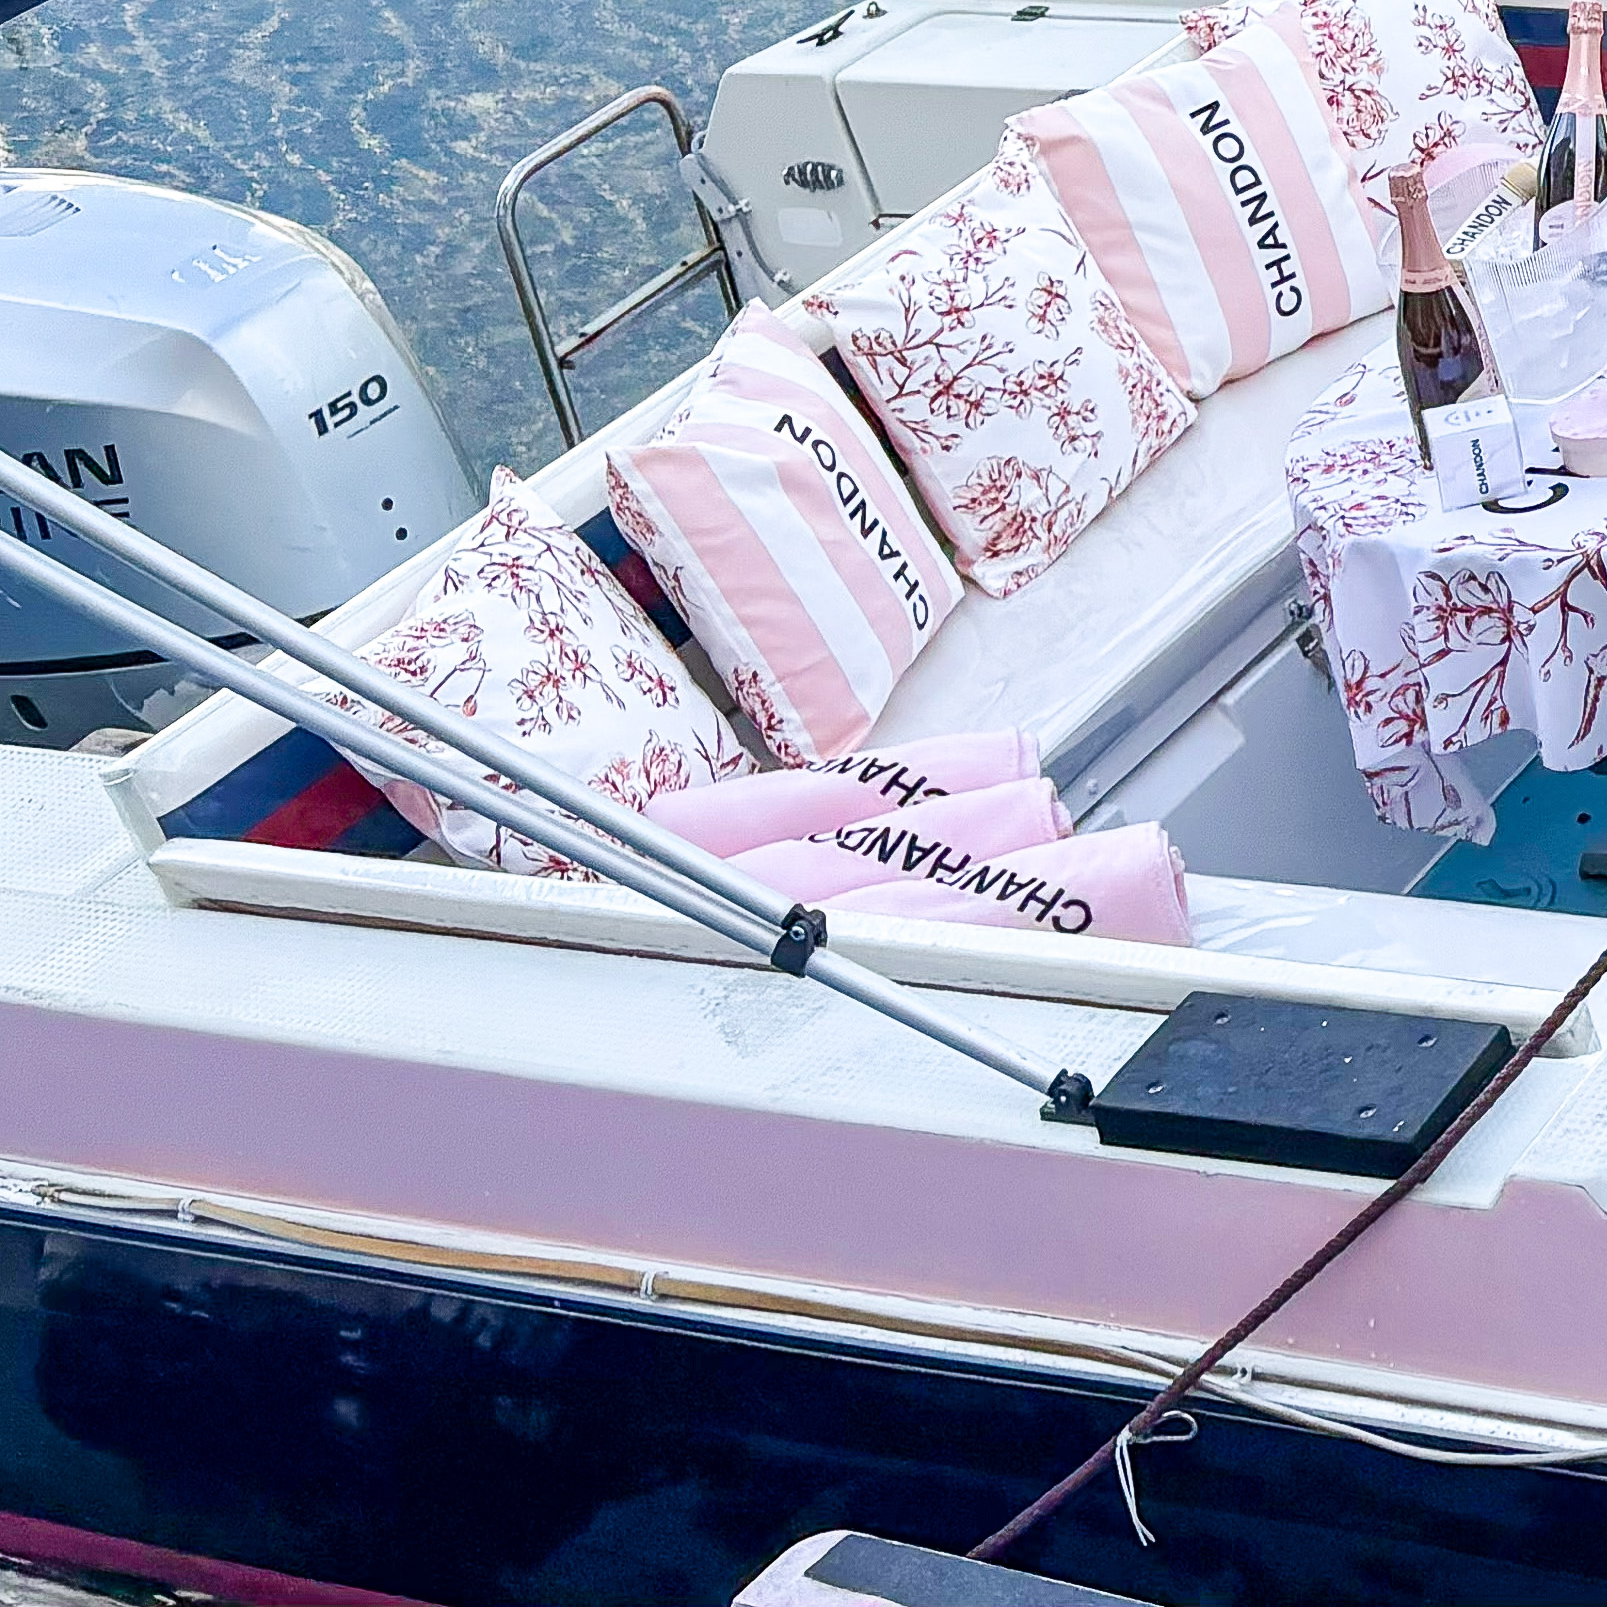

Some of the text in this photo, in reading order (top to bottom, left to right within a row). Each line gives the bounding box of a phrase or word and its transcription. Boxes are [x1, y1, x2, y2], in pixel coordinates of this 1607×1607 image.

[1188, 99, 1303, 317] CHANDON
[1445, 193, 1514, 256] CHANDON
[307, 374, 388, 437] 150
[1470, 437, 1490, 495] CHANDON
[773, 413, 929, 631] CHANDON
